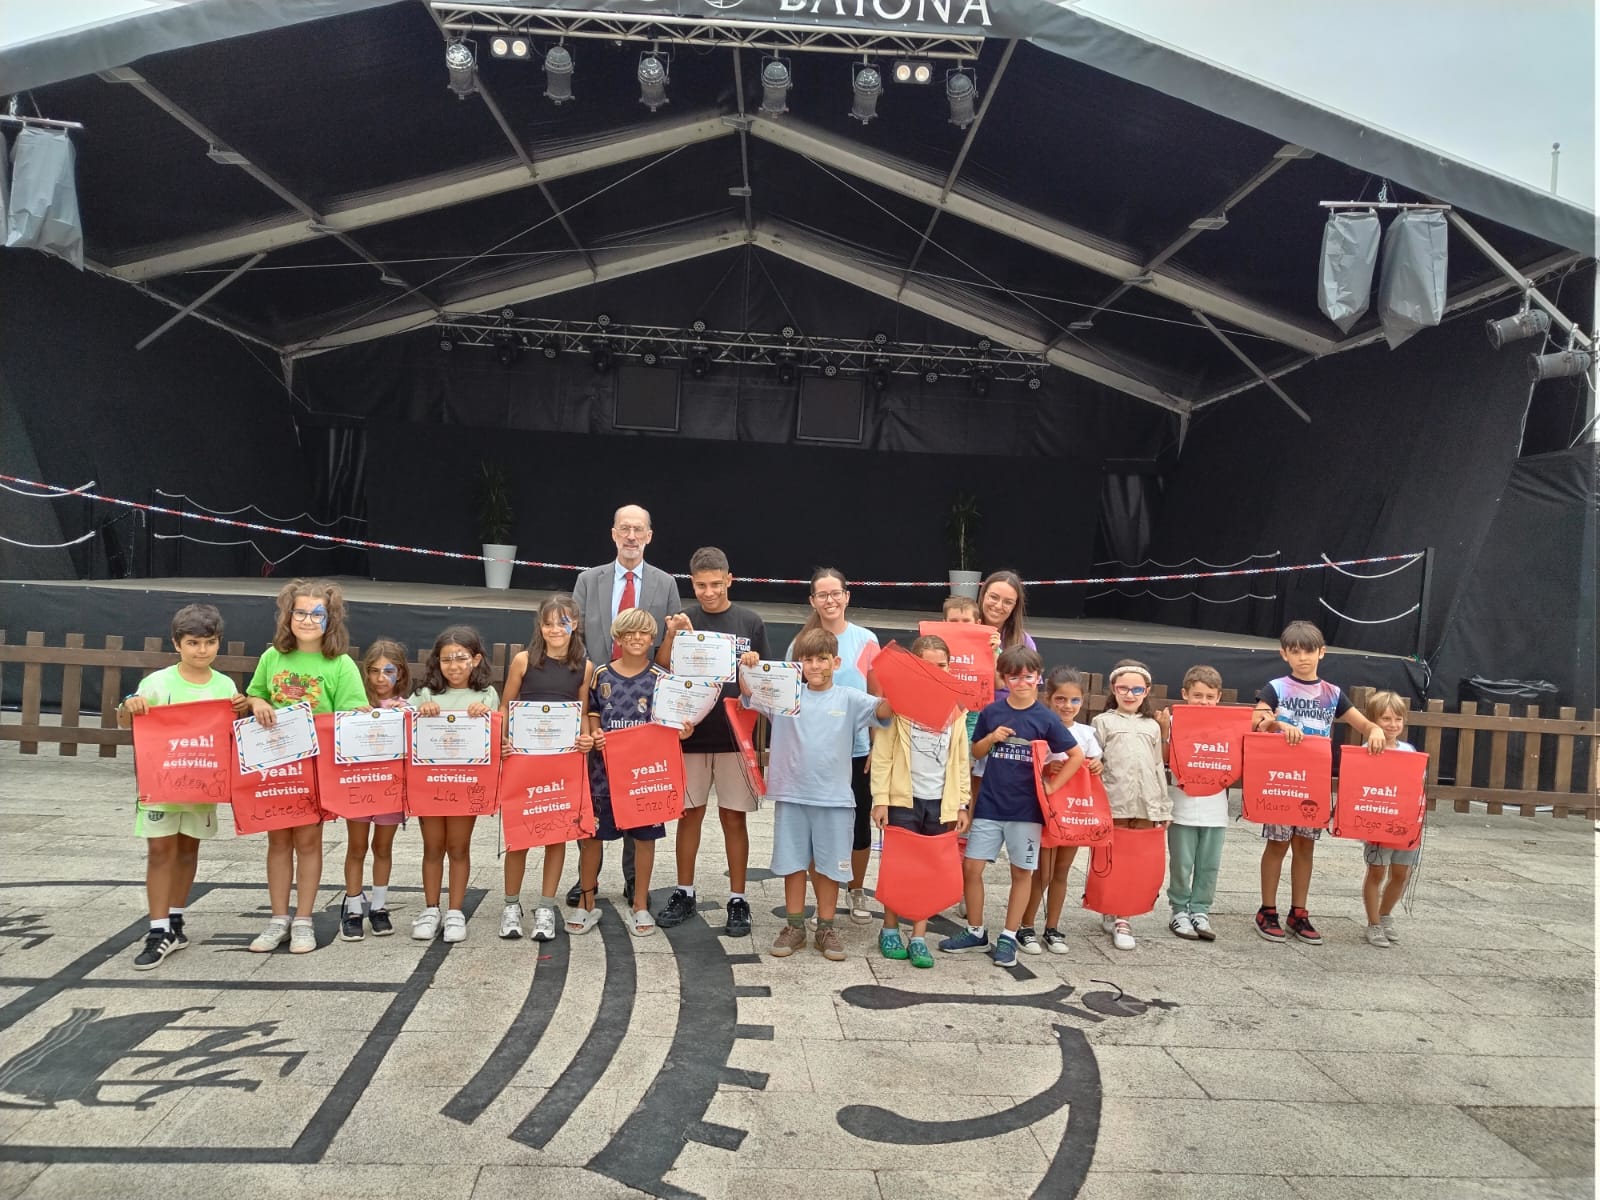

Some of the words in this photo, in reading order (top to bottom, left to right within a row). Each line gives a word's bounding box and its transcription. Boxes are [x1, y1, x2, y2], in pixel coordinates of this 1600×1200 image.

[779, 0, 992, 26] ONA
[949, 654, 975, 665] eah!
[168, 734, 214, 751] yeah!
[1193, 741, 1229, 753] yeah!
[162, 757, 218, 769] activities
[631, 759, 668, 779] yeah!
[1187, 759, 1232, 771] activities
[259, 762, 303, 781] yeah!
[339, 772, 393, 784] activities
[426, 773, 478, 783] activities
[1268, 769, 1306, 782] yeah!
[255, 785, 310, 798] activities
[526, 778, 565, 798] yeah!
[629, 782, 673, 796] activities
[1262, 786, 1310, 799] activities
[1362, 785, 1398, 798] yeah!
[348, 786, 376, 804] Eva
[522, 801, 571, 816] activities
[635, 797, 663, 812] Enzo
[1256, 798, 1291, 812] Mauro
[1354, 803, 1399, 815] activities
